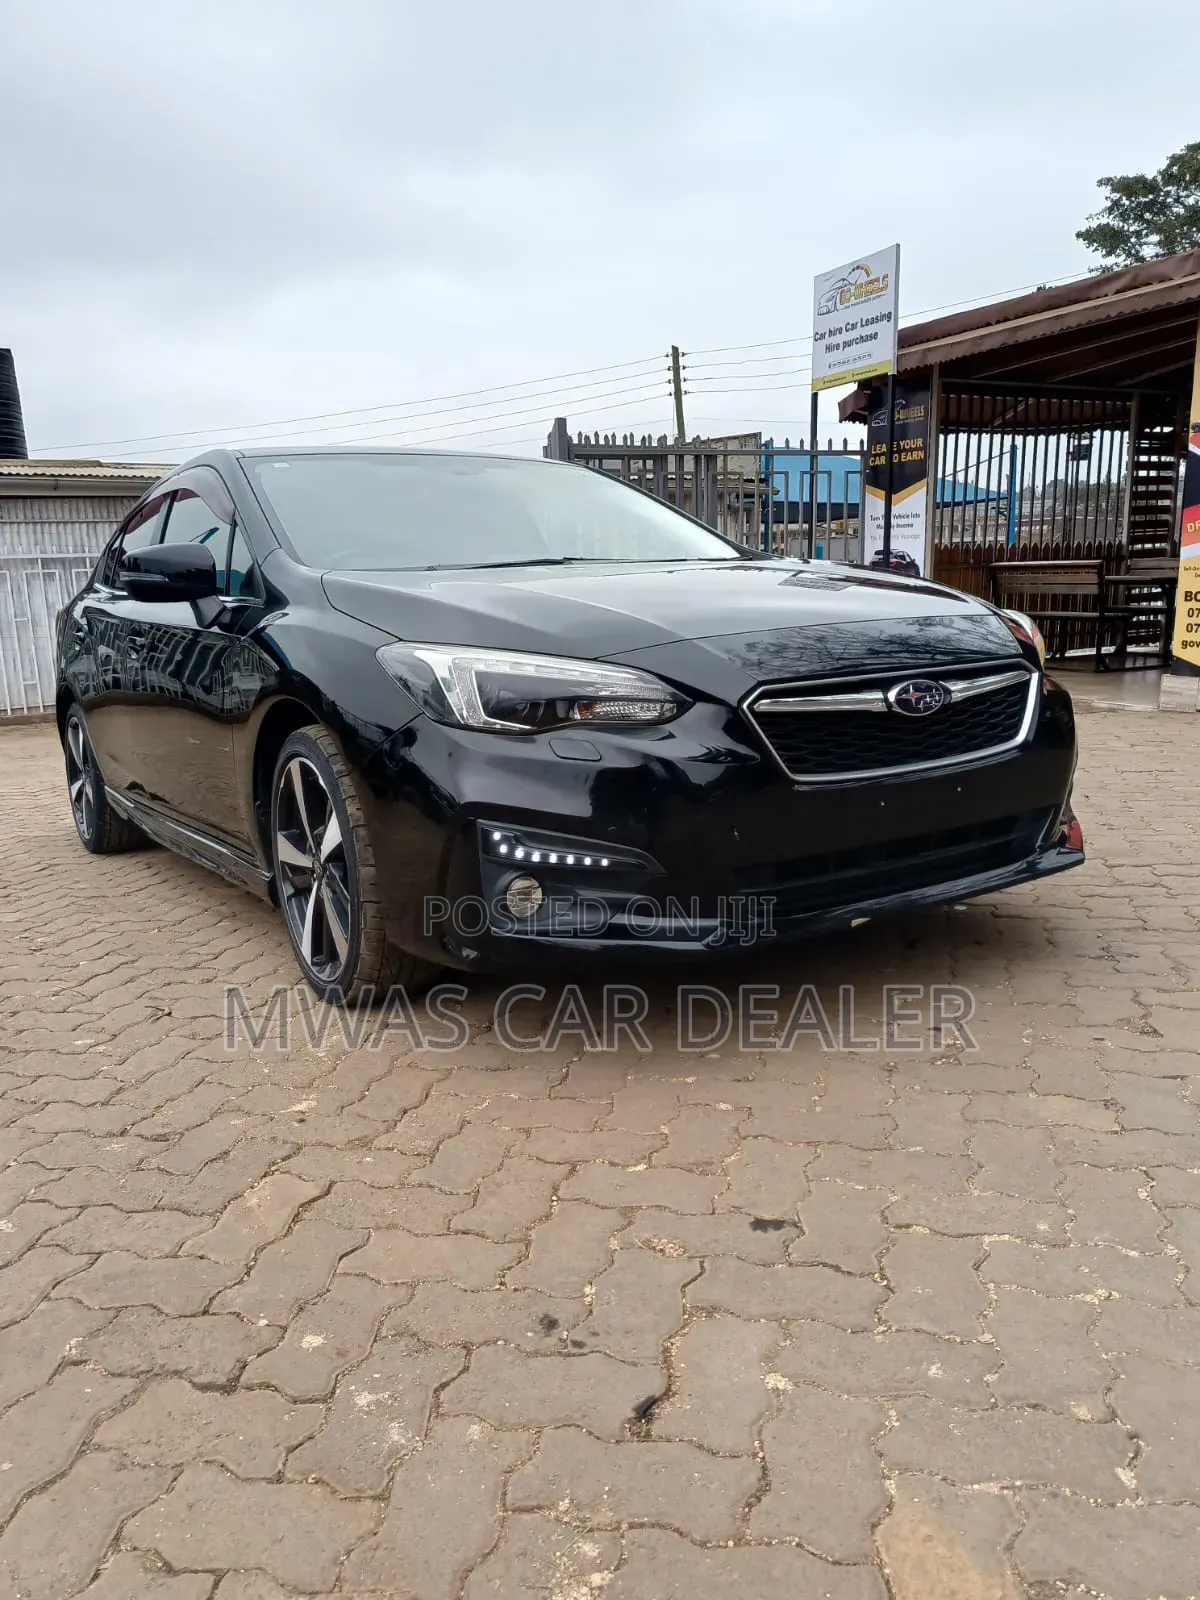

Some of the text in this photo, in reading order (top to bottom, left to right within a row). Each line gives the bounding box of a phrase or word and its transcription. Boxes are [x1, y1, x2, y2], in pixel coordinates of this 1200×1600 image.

[814, 311, 892, 342] Car hire Car Leasing
[825, 331, 879, 354] Hire purchase
[871, 437, 923, 455] LEAE YOUR
[869, 455, 886, 466] CAR
[901, 450, 925, 462] EARN
[1187, 607, 1200, 618] 07
[1186, 622, 1200, 633] 07
